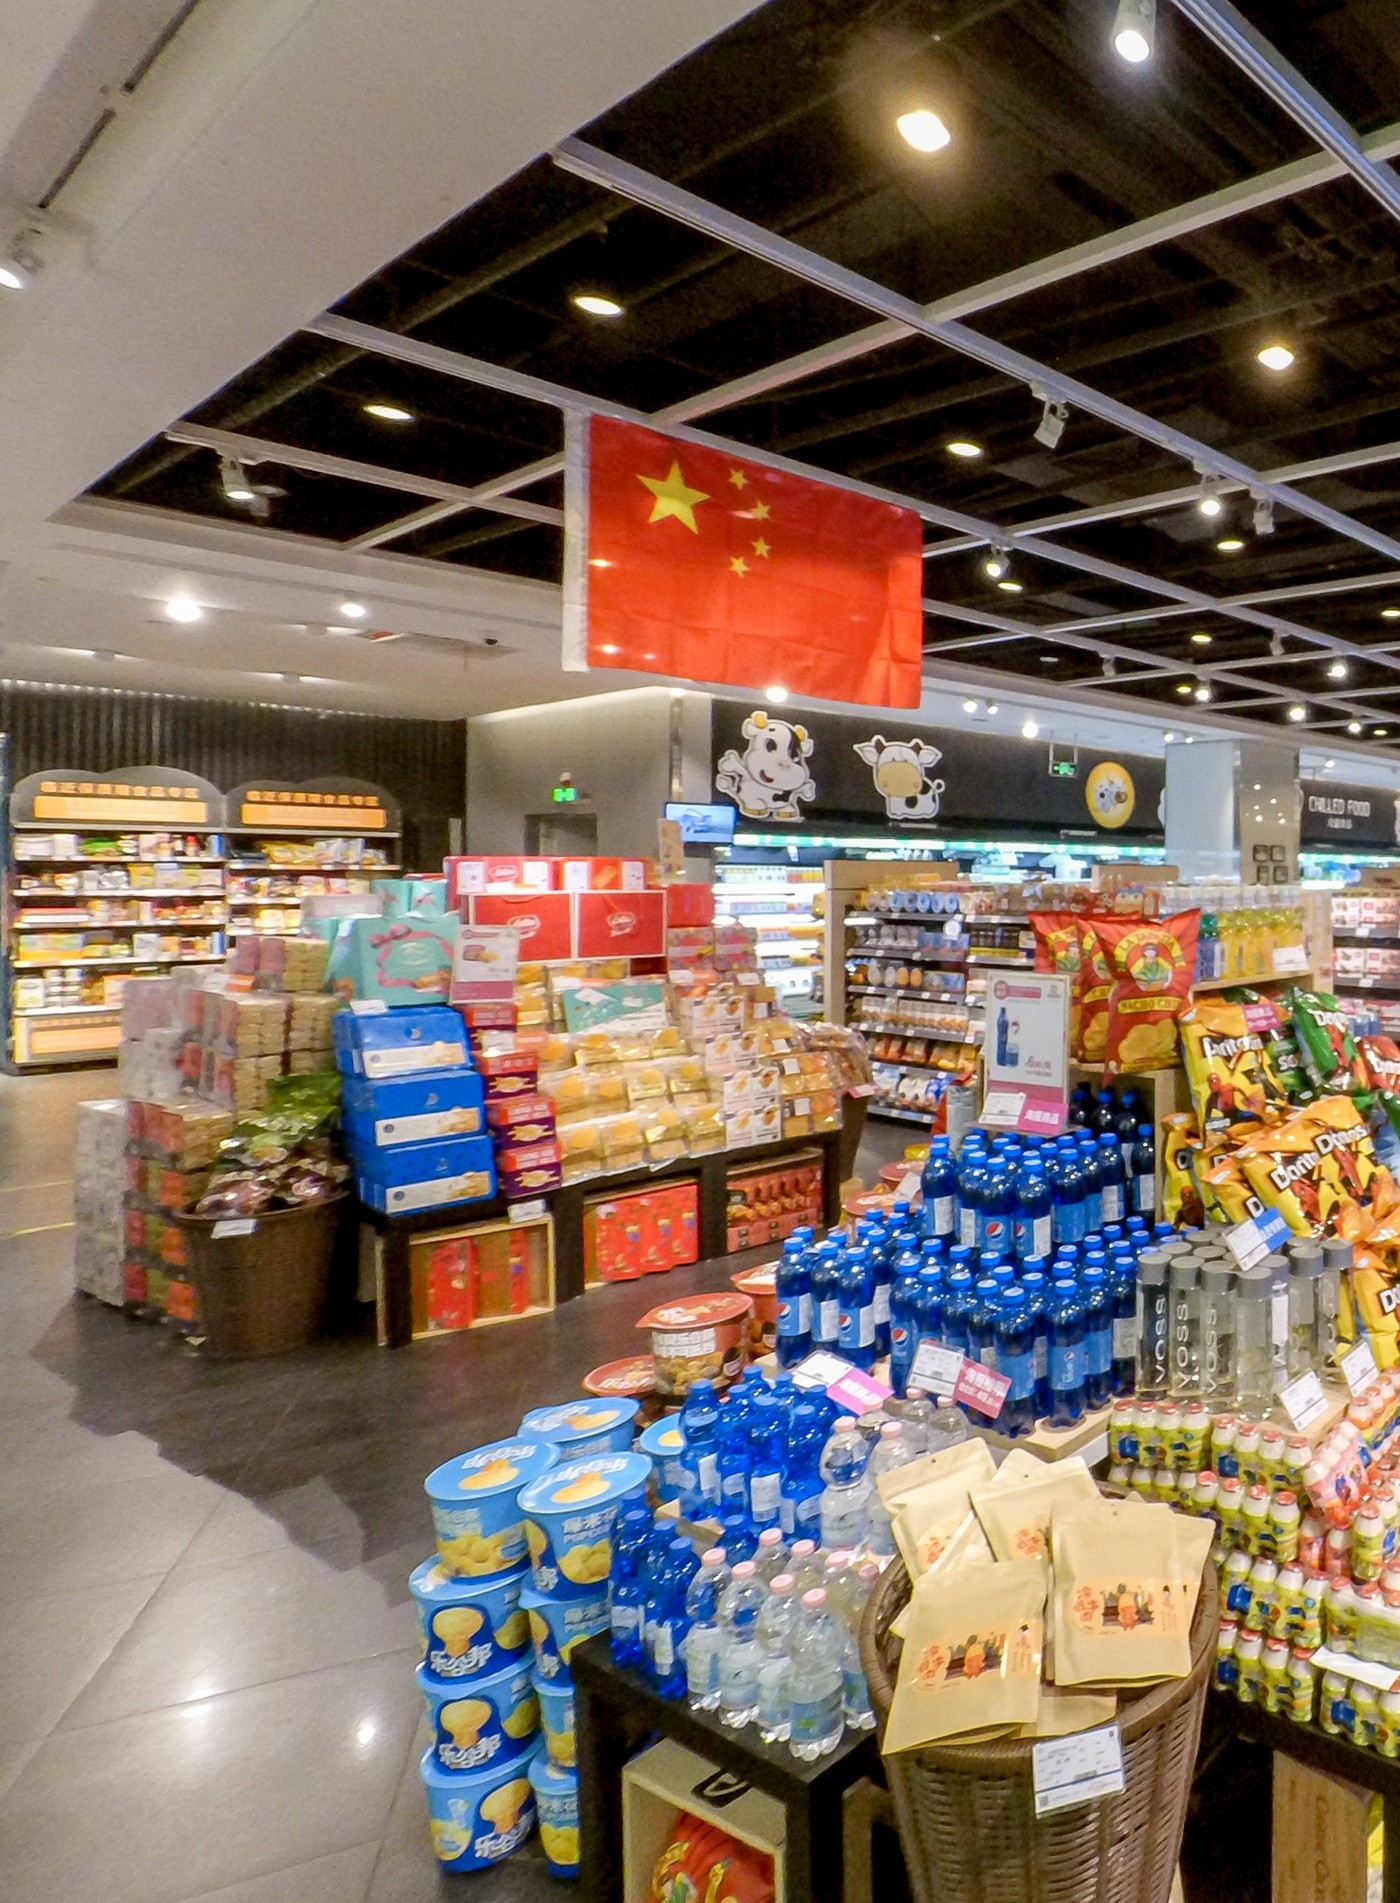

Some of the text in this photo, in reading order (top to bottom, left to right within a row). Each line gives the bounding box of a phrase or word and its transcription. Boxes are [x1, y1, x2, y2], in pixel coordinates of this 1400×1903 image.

[1154, 1296, 1166, 1384] VOSS
[1176, 1303, 1190, 1388] VOSS
[1204, 1307, 1218, 1394] VOSS
